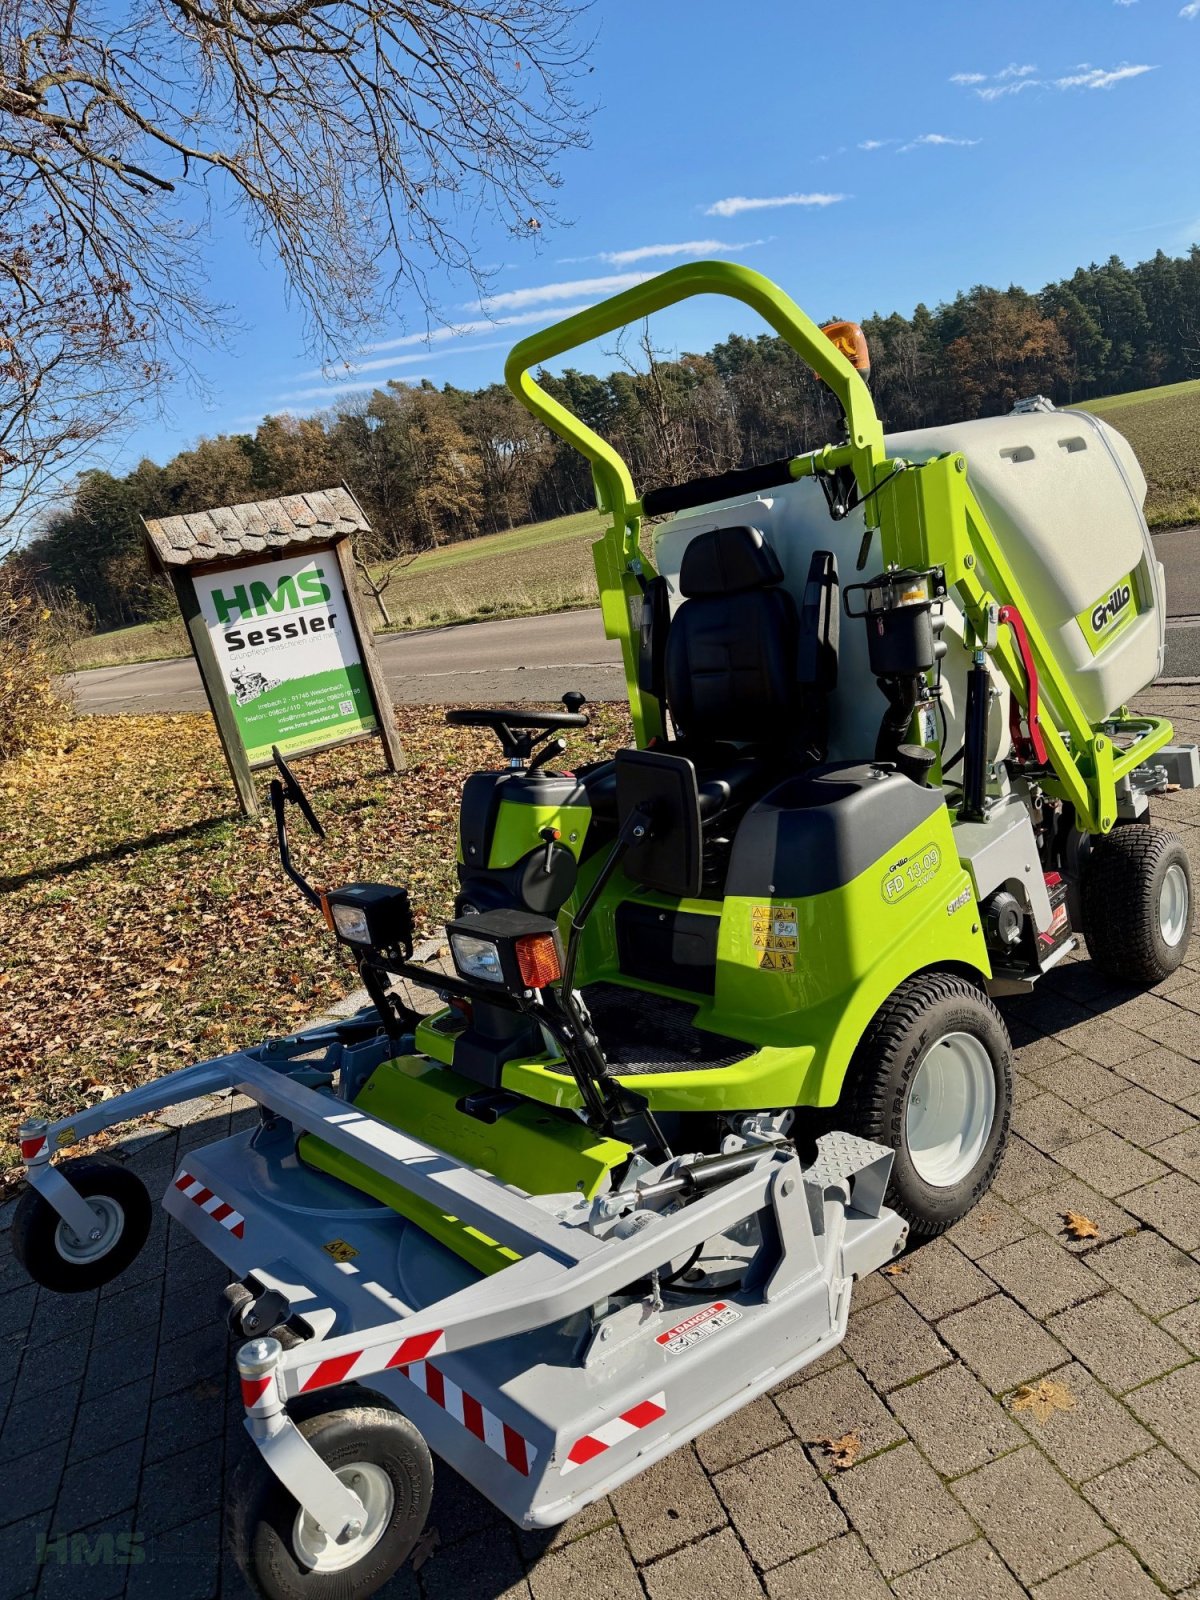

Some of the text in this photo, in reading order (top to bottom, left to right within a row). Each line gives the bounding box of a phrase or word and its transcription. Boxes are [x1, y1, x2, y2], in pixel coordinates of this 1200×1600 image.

[210, 568, 332, 624] HMS
[1091, 585, 1130, 632] Grillo
[224, 613, 337, 653] Sessler
[277, 712, 340, 734] www.hms-sessler.de
[885, 849, 939, 898] FD 13.09
[889, 857, 908, 873] Grillo
[890, 1027, 930, 1150] CARLISLE
[675, 1307, 719, 1335] DANGER
